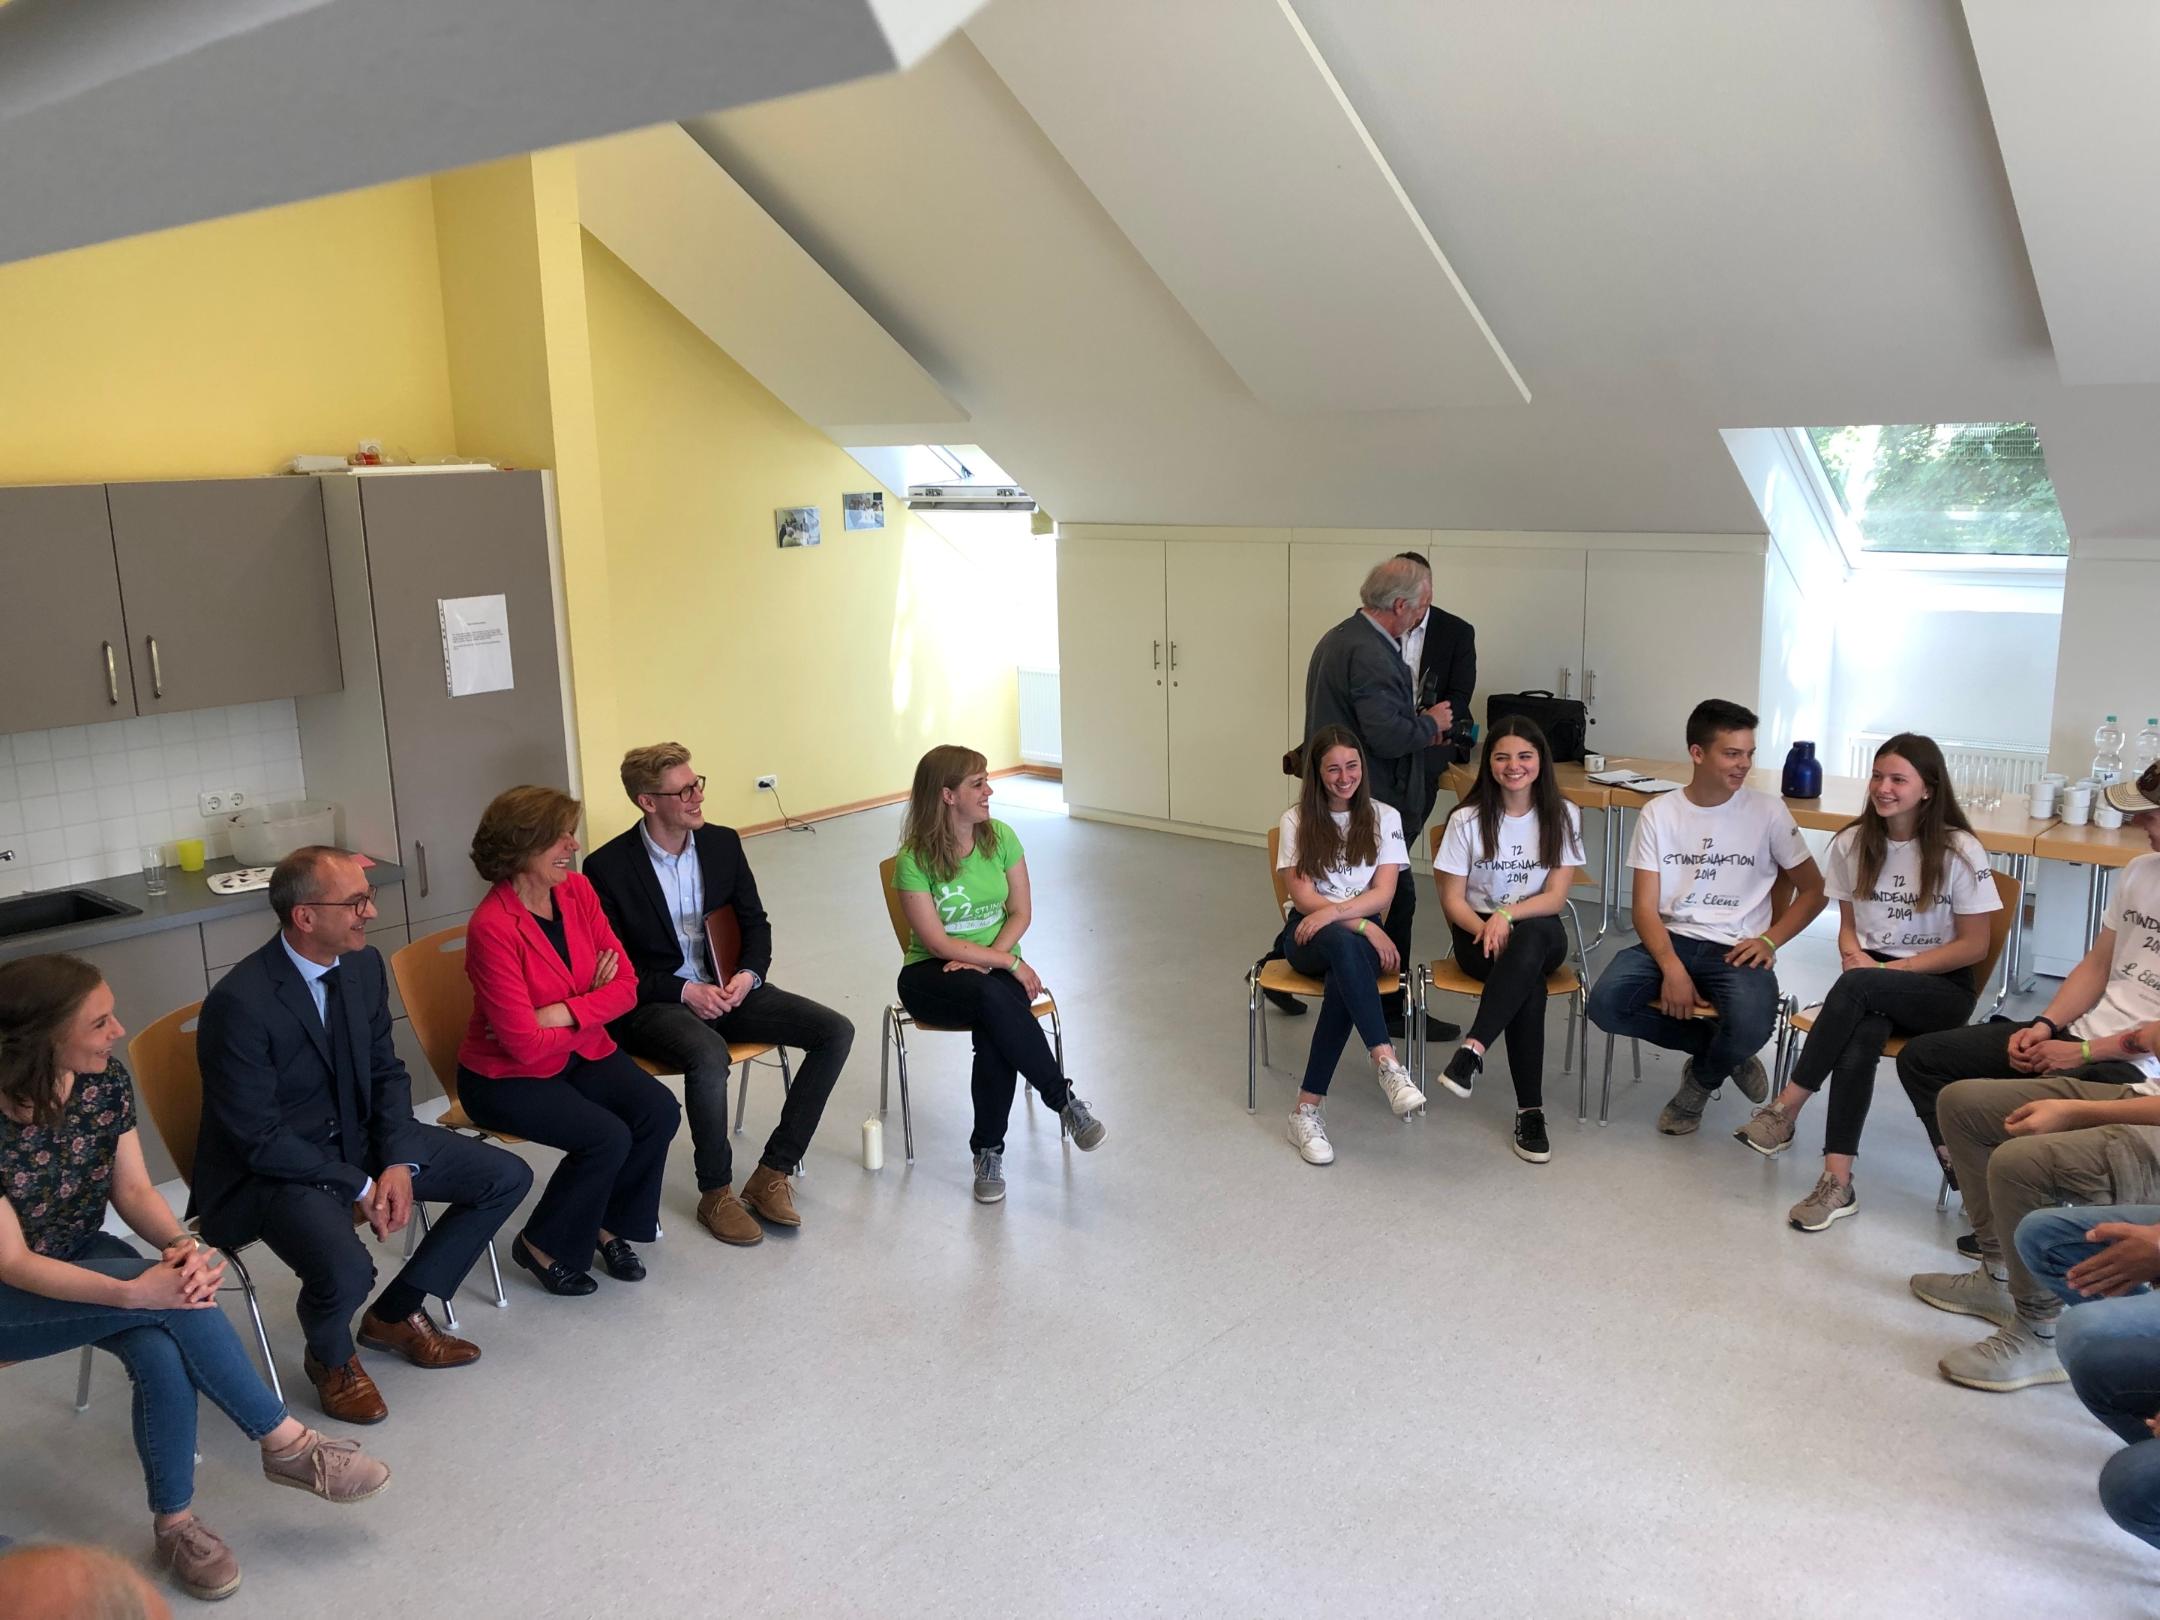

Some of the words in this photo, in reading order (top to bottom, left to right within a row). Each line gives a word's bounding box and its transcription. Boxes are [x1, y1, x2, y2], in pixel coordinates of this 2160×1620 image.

[1702, 837, 1715, 850] 72
[1511, 845, 1524, 857] 72
[1473, 860, 1550, 871] STUNDENAK
[1662, 853, 1756, 867] STUNDENAKTION
[1506, 872, 1529, 884] 2019
[1694, 867, 1717, 881] 2019
[1892, 875, 1907, 888] 72
[1702, 893, 1741, 907] Elenz
[941, 902, 972, 922] 72
[1887, 906, 1913, 921] 2019
[1902, 933, 1942, 946] Elenz
